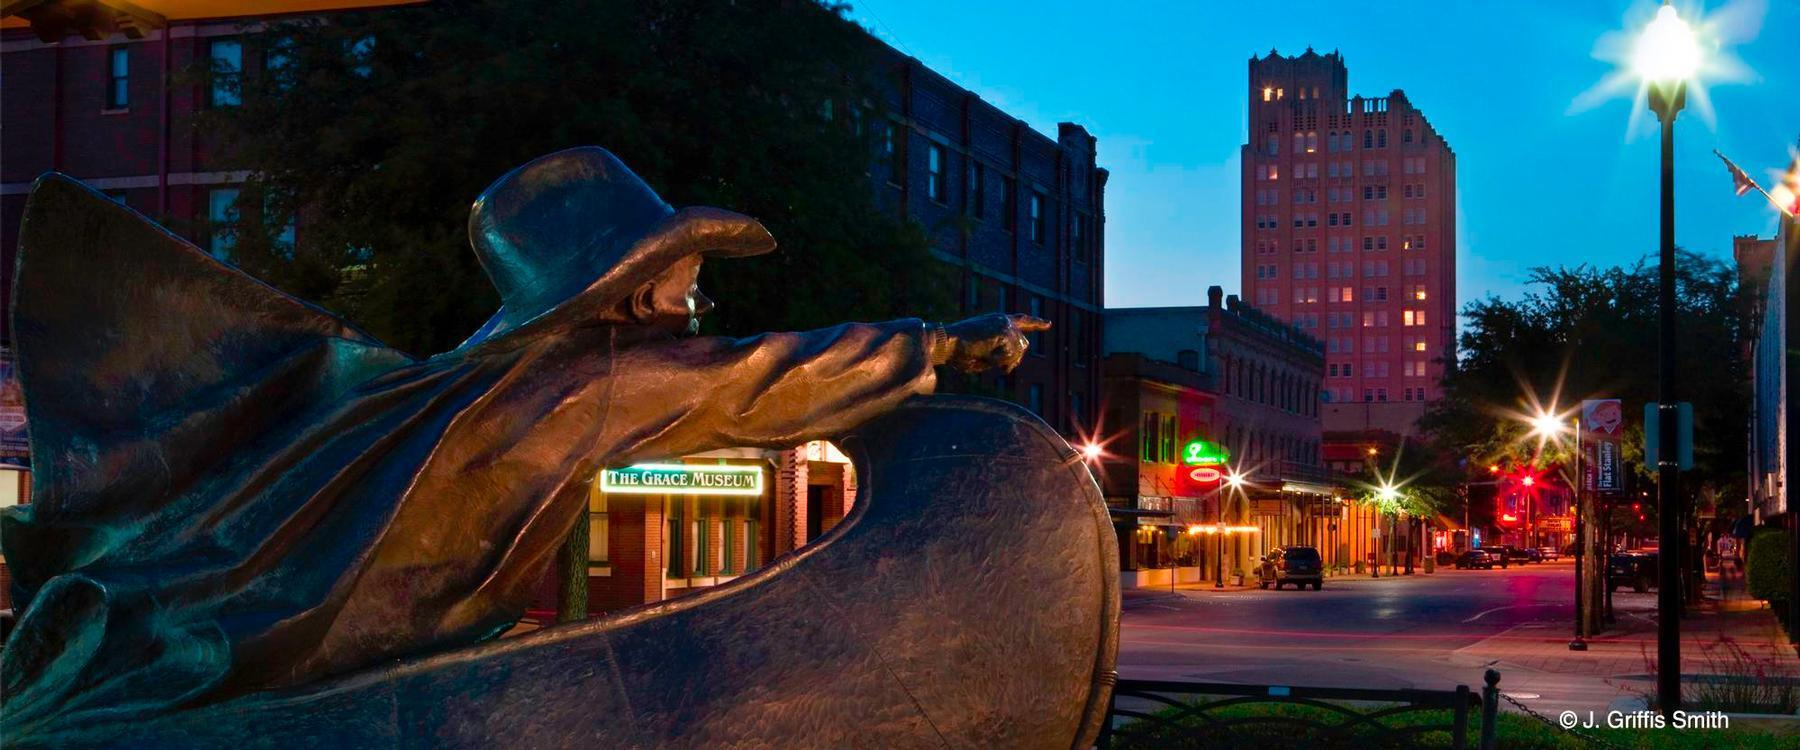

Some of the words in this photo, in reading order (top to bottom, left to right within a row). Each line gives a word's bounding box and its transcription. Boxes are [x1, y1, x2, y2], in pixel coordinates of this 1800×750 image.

[1602, 441, 1613, 471] Stanley
[608, 471, 639, 485] THE
[641, 471, 688, 486] GRACE
[691, 472, 755, 487] MUSEUM
[1602, 472, 1612, 488] Flat
